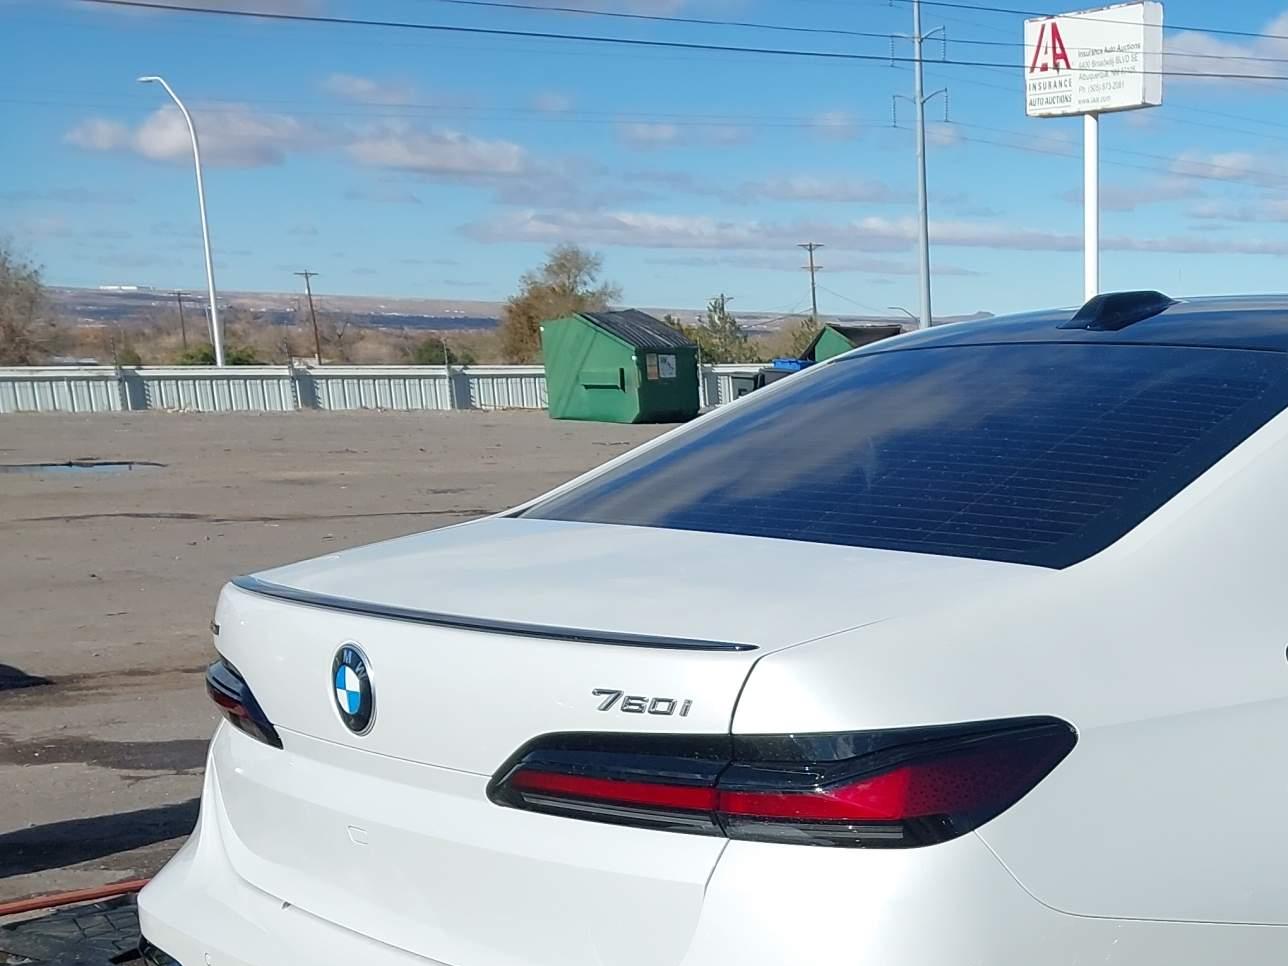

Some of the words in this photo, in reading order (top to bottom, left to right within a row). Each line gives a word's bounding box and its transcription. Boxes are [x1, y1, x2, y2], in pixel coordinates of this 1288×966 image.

[1028, 79, 1073, 92] INSURANCE
[1029, 97, 1044, 107] AUTO
[1045, 94, 1073, 105] AUCTIONS
[591, 688, 693, 717] 760i
